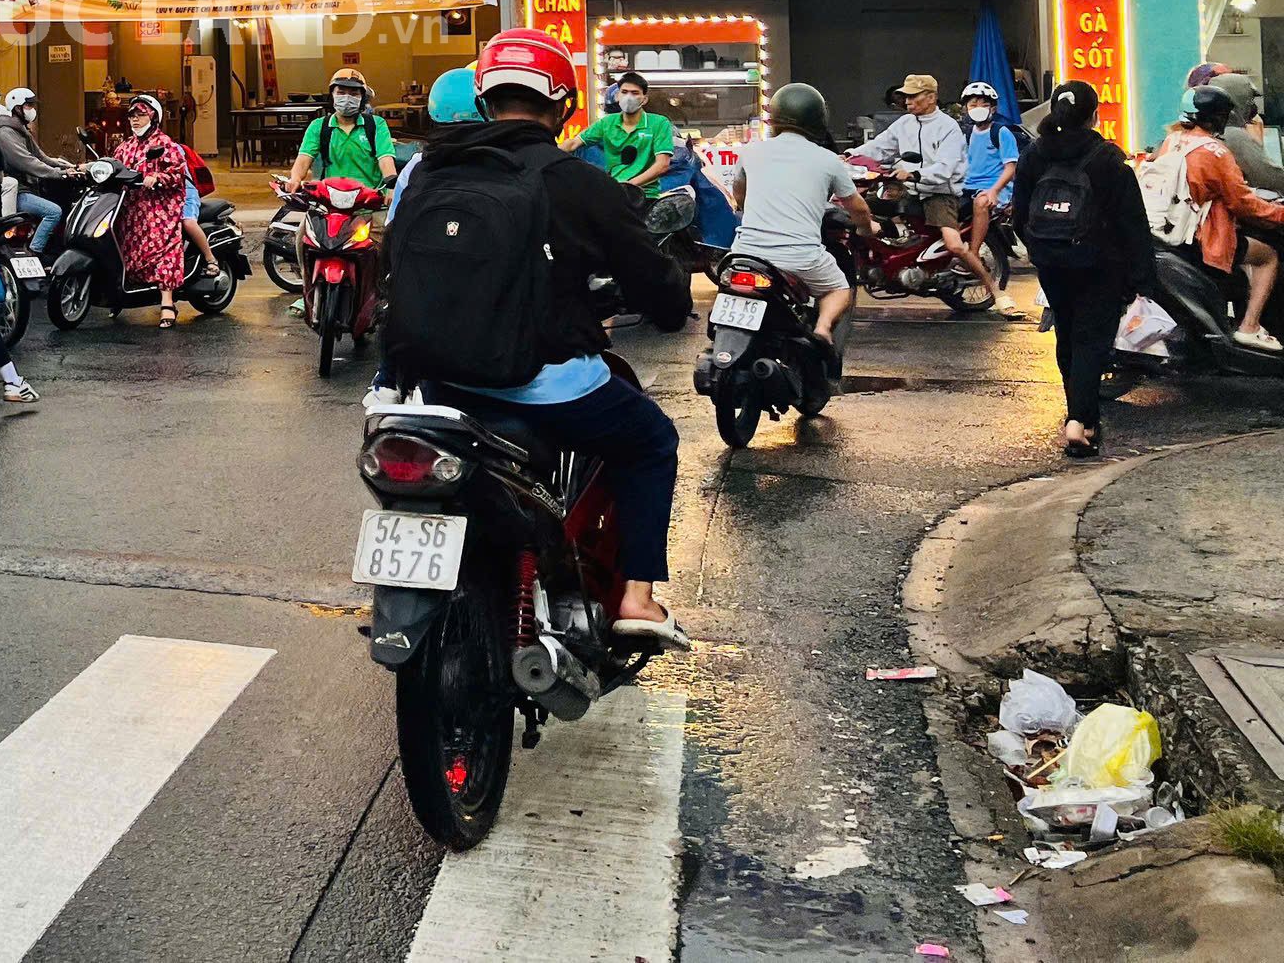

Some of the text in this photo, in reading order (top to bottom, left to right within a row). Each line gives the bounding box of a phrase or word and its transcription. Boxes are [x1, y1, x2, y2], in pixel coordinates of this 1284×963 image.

[1079, 6, 1108, 33] GÀ
[1073, 37, 1115, 69] SỐT
[375, 516, 448, 548] 54-S6
[369, 548, 444, 582] 8576
